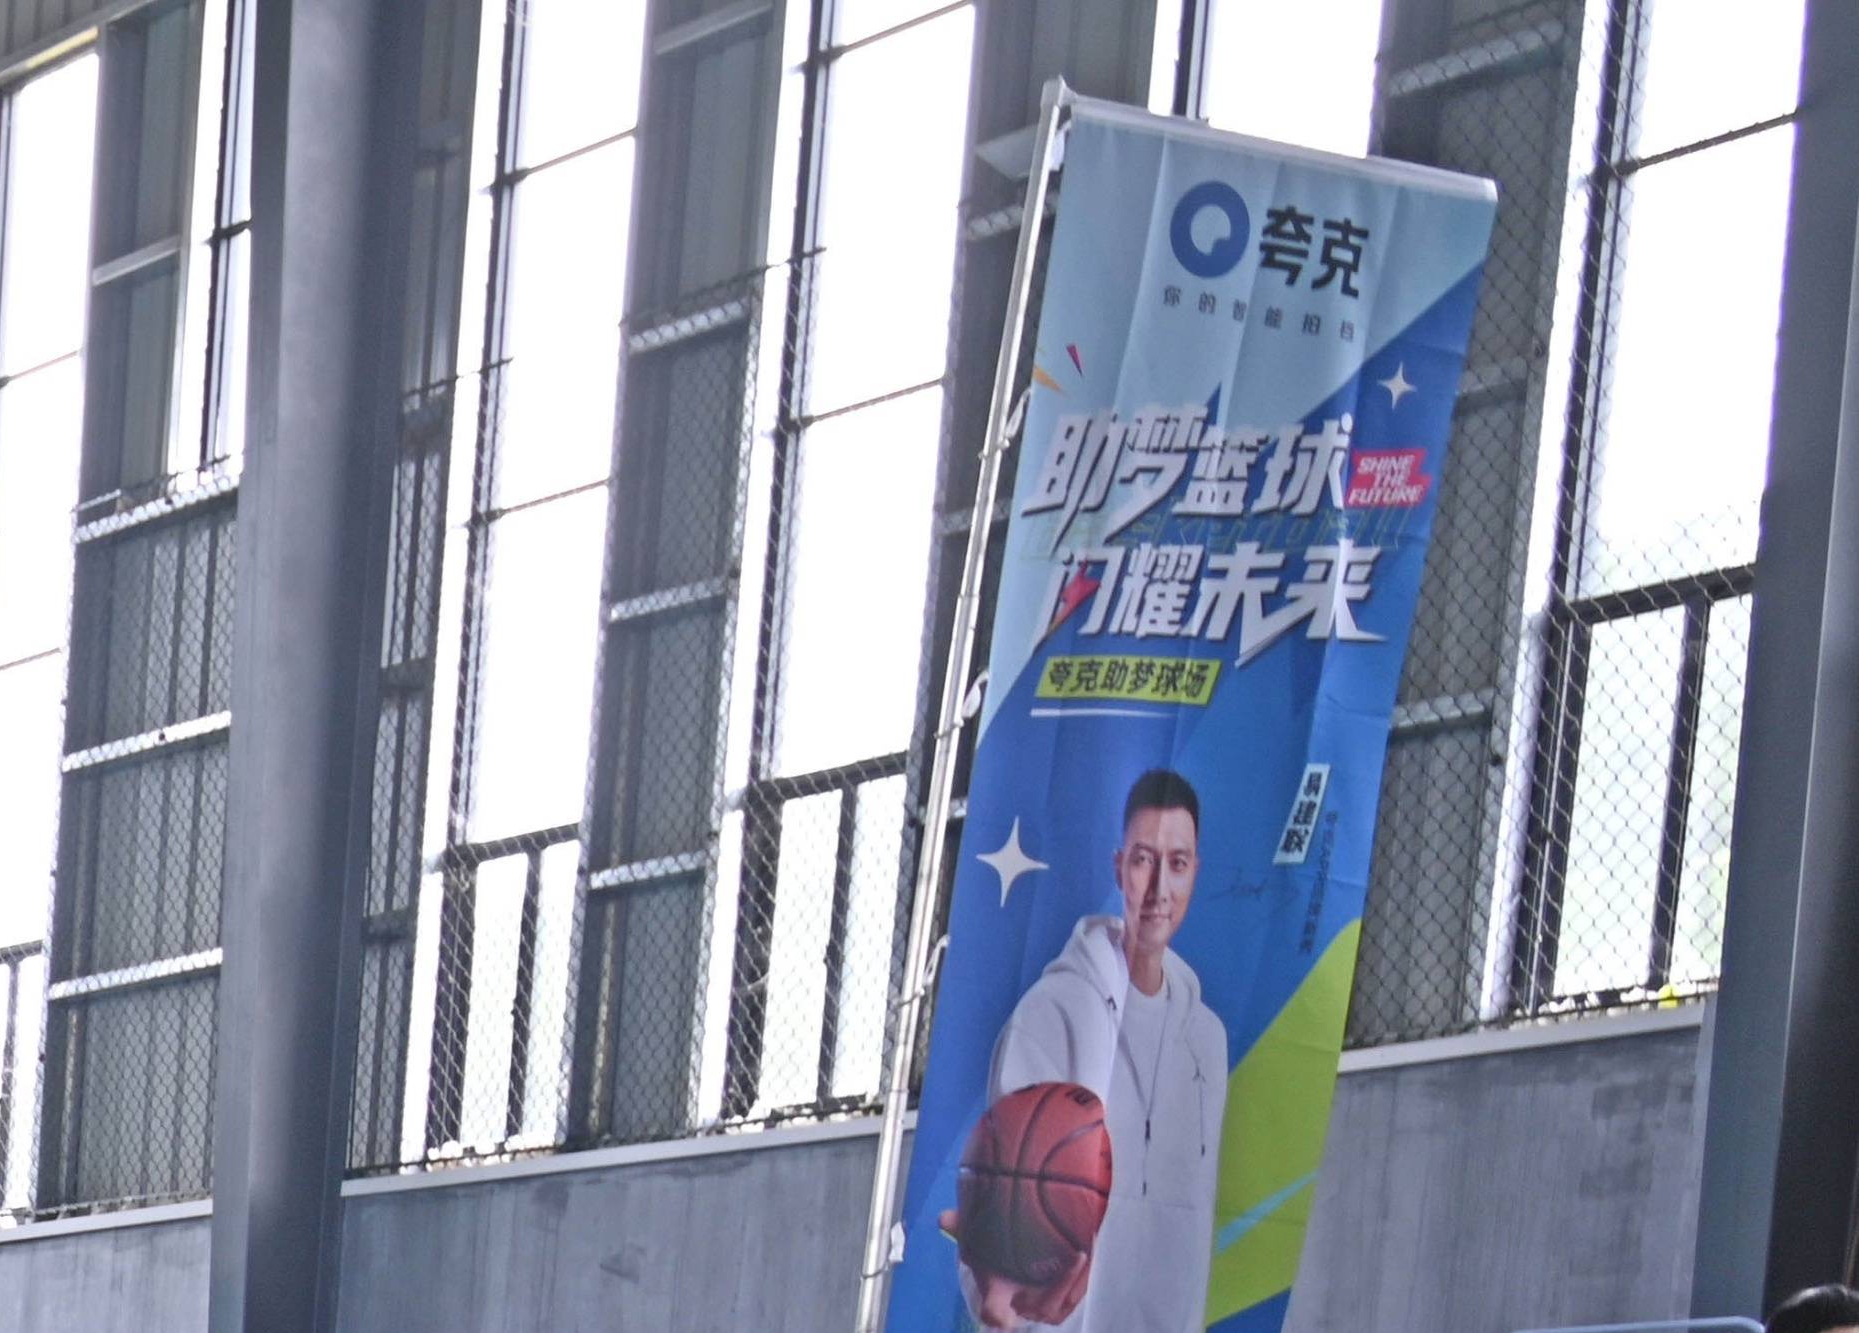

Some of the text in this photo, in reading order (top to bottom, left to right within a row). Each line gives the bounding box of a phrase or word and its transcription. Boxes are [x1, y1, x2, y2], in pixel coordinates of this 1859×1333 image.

[1259, 205, 1369, 299] 夸克
[1021, 405, 1353, 557] 助梦篮球
[1029, 538, 1388, 668] 闪耀未来
[1049, 659, 1211, 698] 夸克助梦球场
